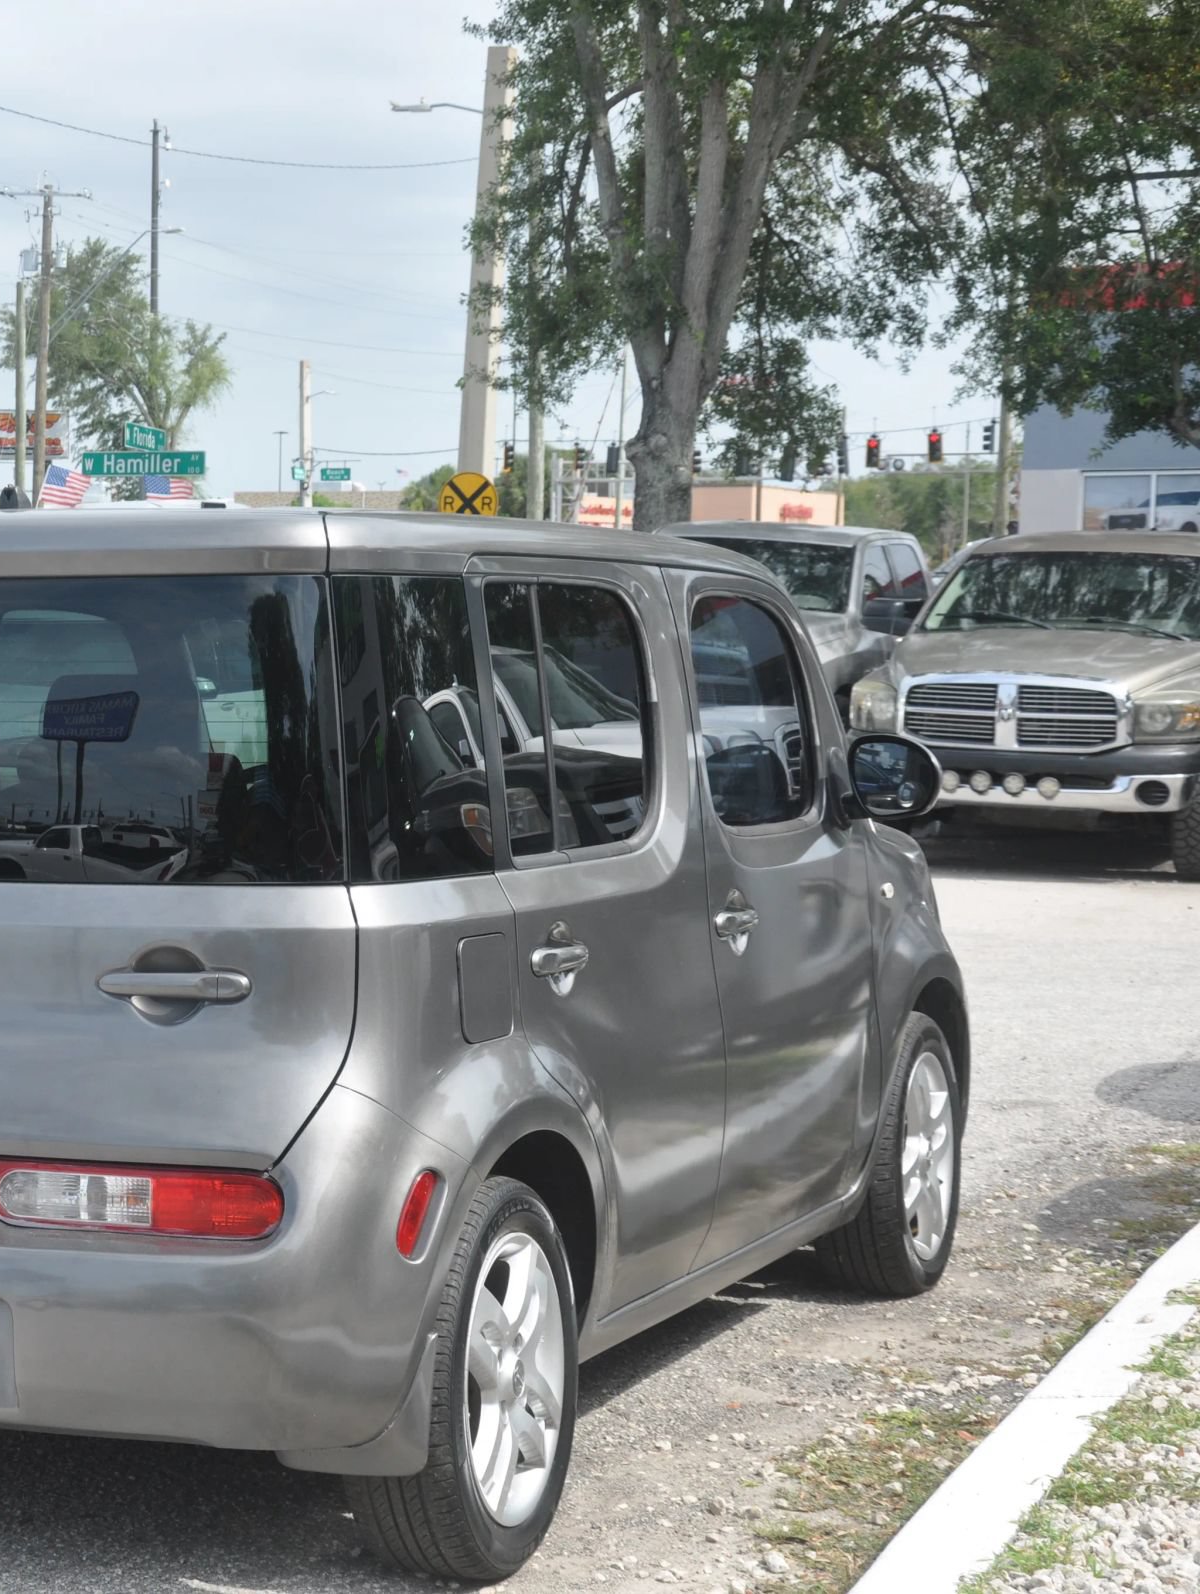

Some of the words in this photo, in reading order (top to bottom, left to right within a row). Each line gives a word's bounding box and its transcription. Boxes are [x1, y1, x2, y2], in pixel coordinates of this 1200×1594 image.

[133, 426, 156, 449] Florida
[84, 457, 95, 472] W
[102, 453, 182, 474] Hamiller
